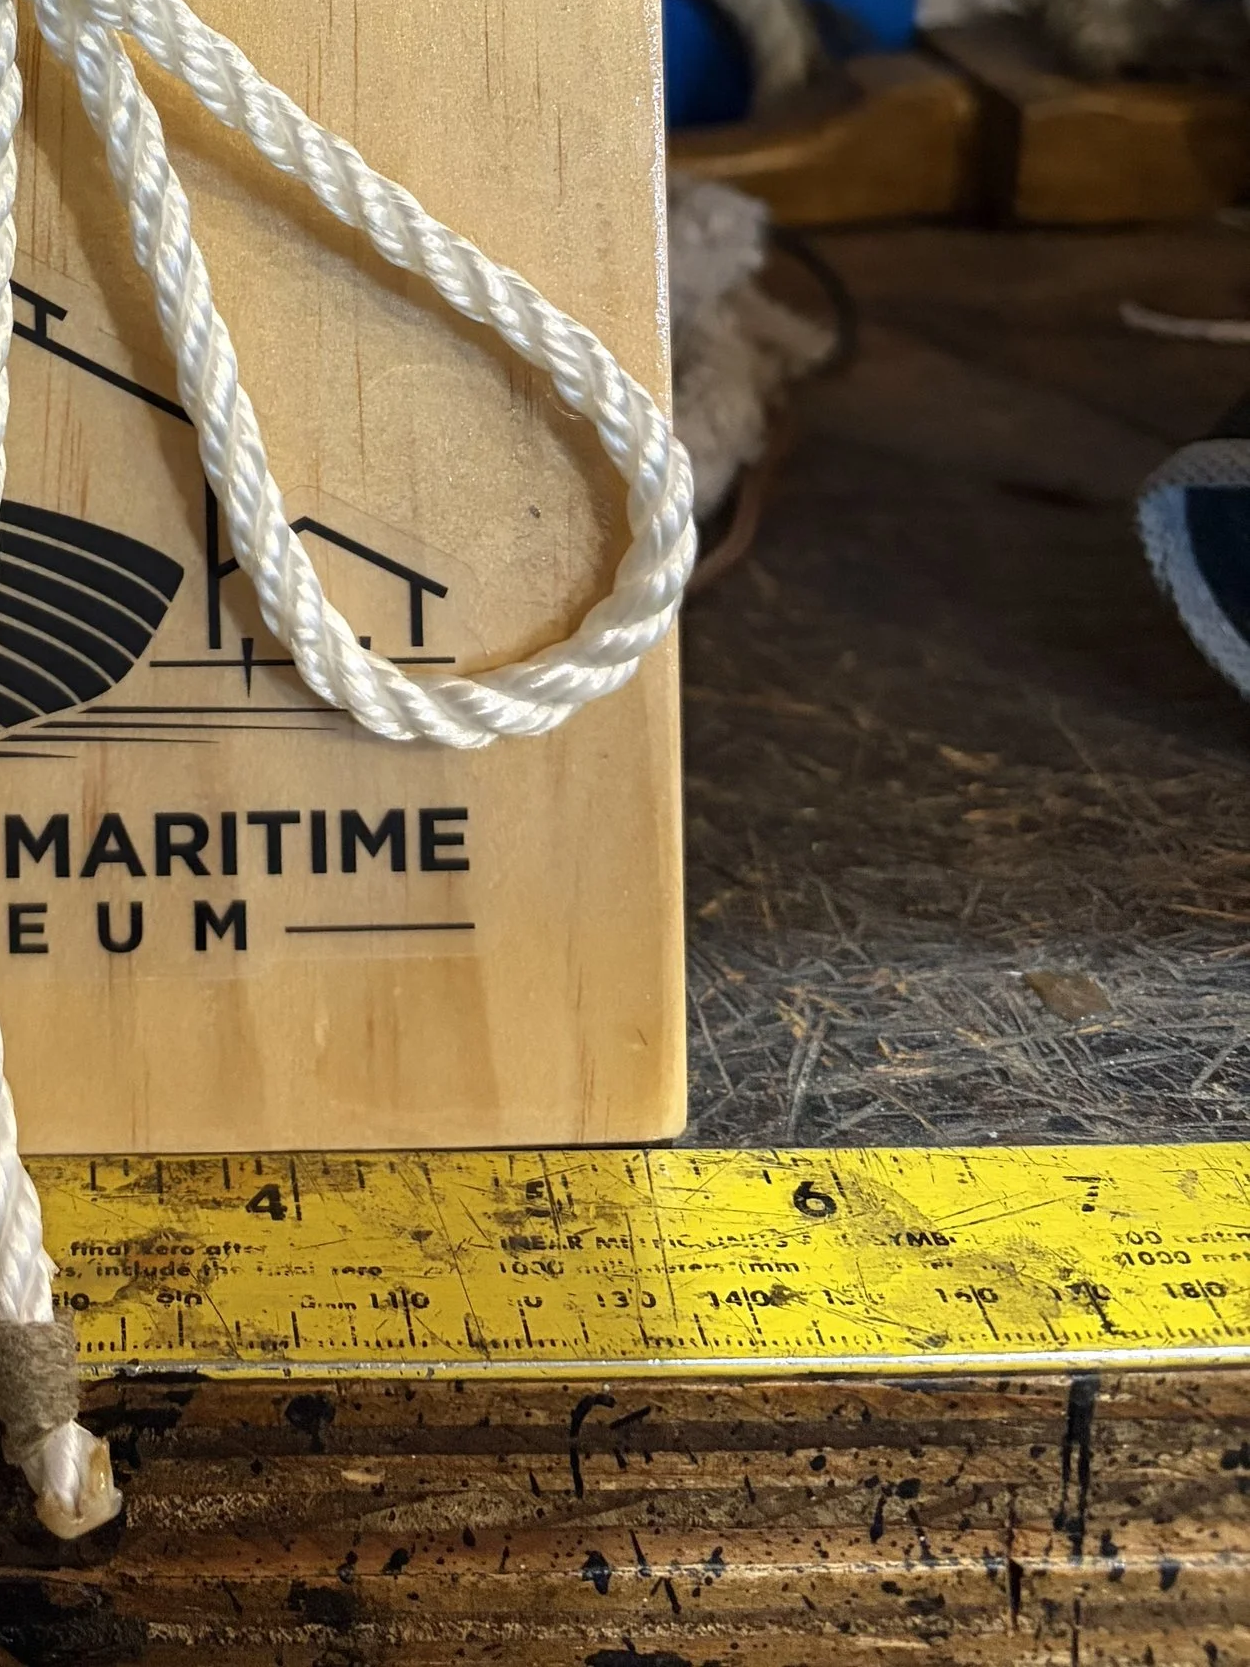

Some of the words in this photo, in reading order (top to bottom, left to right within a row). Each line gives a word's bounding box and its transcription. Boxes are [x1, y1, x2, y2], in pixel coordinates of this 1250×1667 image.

[4, 808, 470, 879] MARITIME
[246, 1184, 287, 1221] 4
[793, 1181, 837, 1218] 6
[370, 1290, 430, 1309] 110
[706, 1289, 771, 1308] 140
[1162, 1281, 1227, 1299] 180
